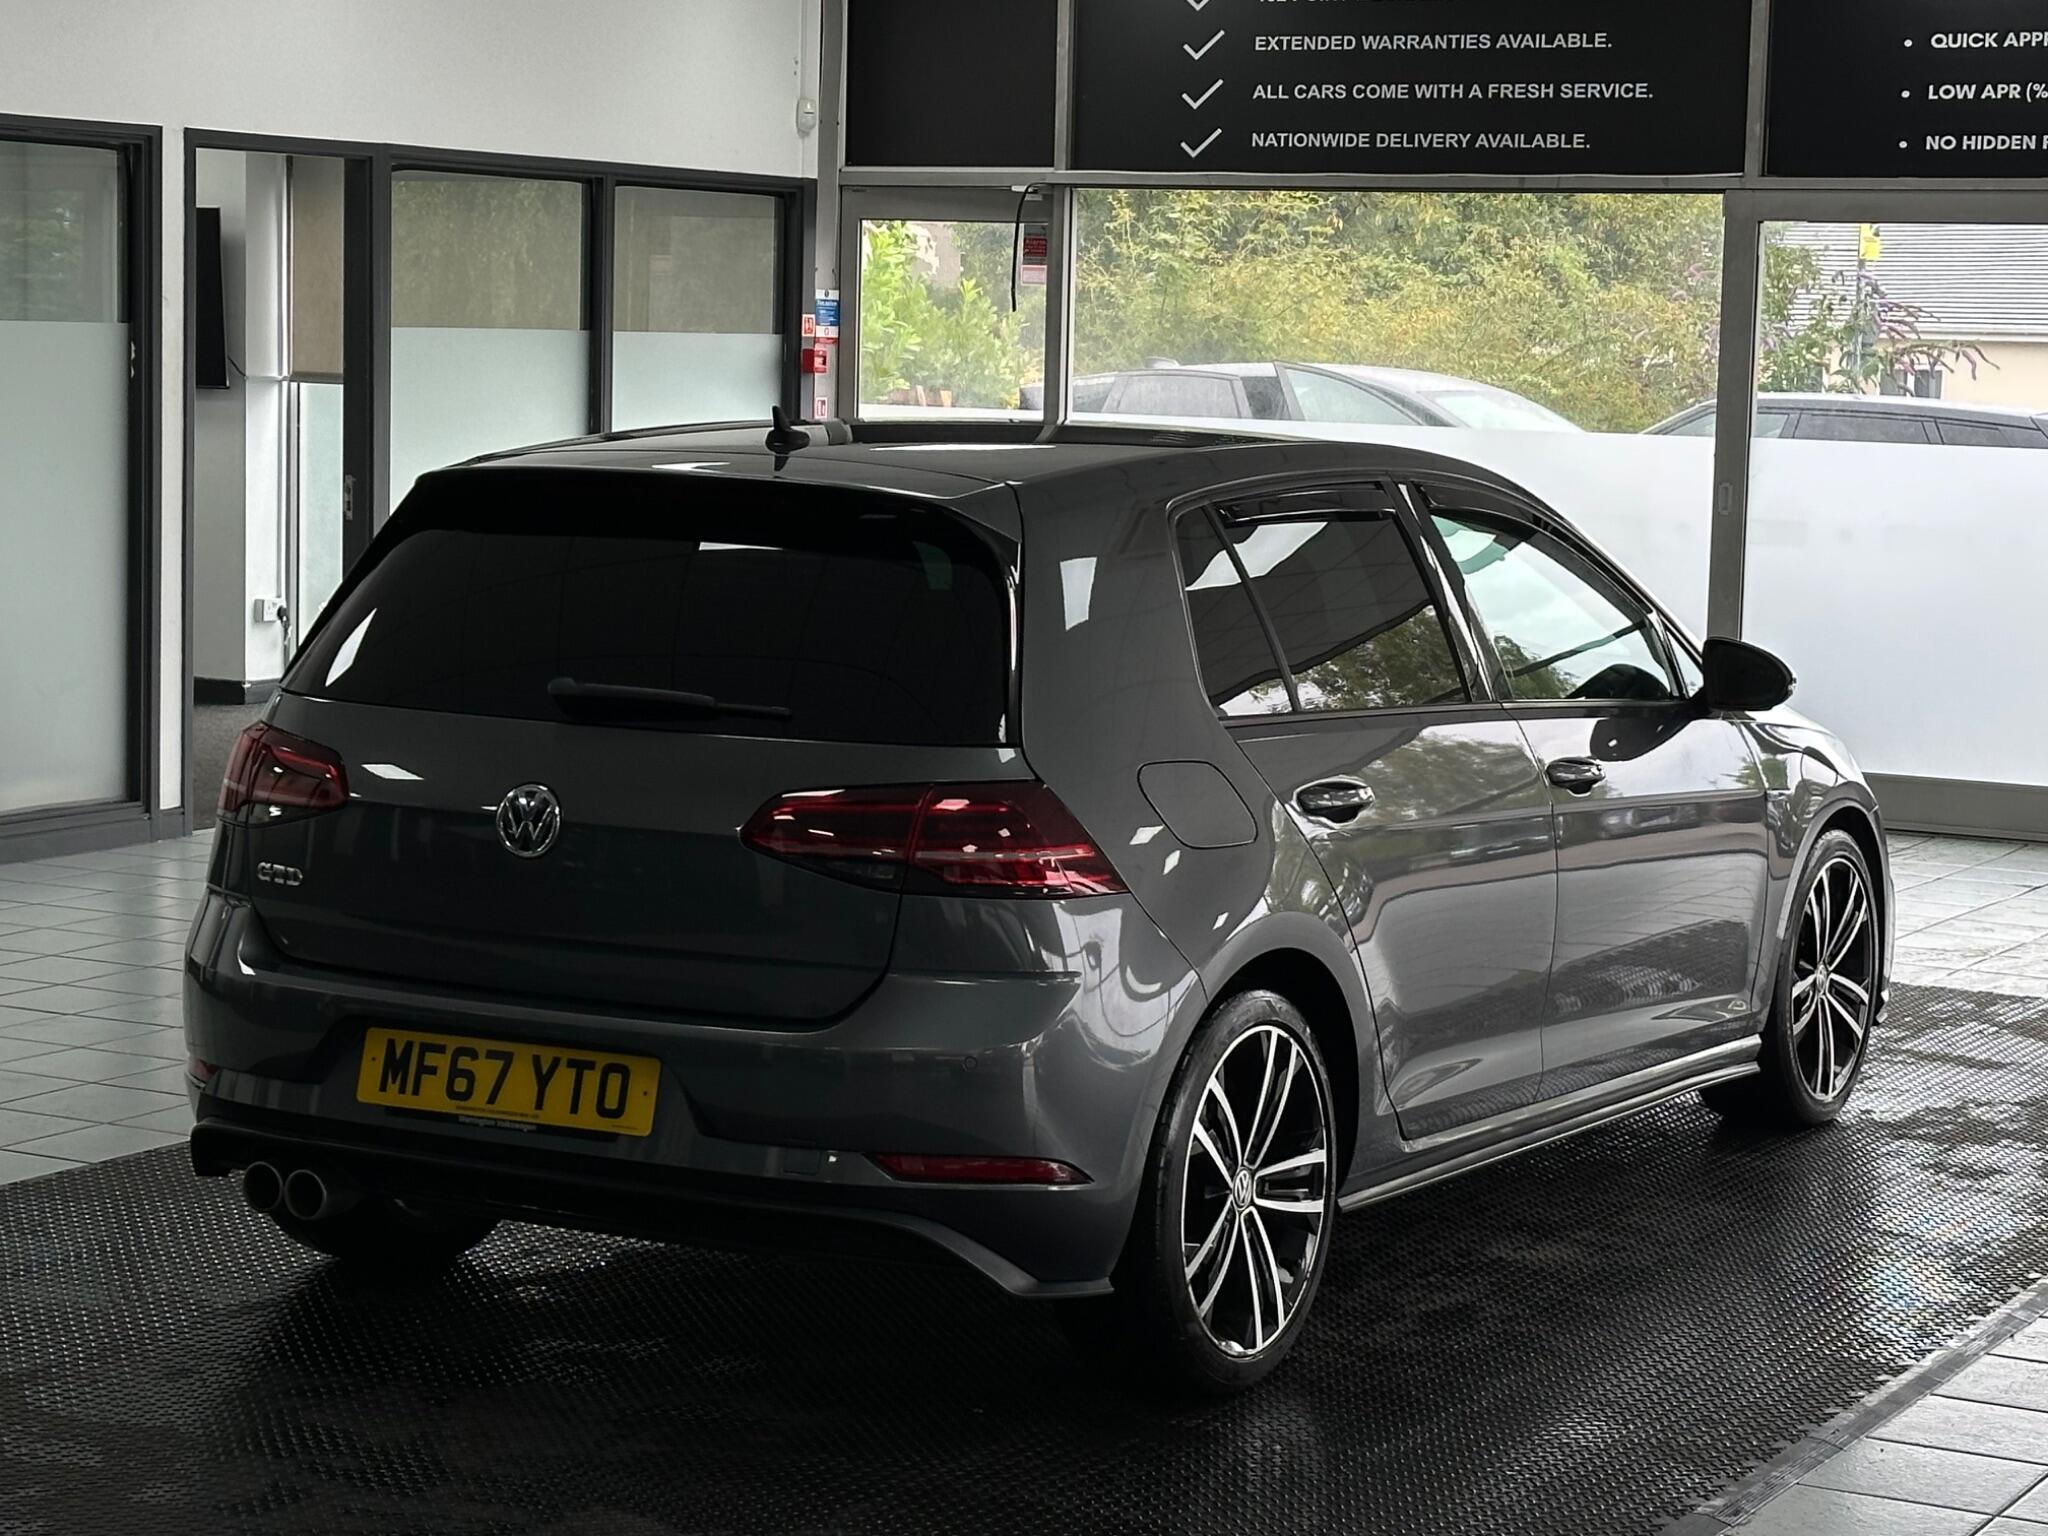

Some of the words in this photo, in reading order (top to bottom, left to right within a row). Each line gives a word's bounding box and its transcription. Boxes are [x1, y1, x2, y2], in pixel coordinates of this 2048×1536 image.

[1254, 35, 1356, 51] EXTENDED
[1361, 33, 1491, 50] WARRANTIES
[1495, 32, 1612, 49] AVAILABLE.
[1930, 31, 1999, 48] QUICK
[1252, 84, 1290, 100] ALL
[1294, 84, 1347, 99] CARS
[1352, 84, 1410, 99] COME
[1414, 83, 1464, 99] WITH
[1468, 83, 1483, 99] A
[1488, 83, 1554, 99] FRESH
[1559, 82, 1653, 99] SERVICE.
[1928, 84, 1977, 100] LOW
[1980, 83, 2022, 99] APR
[1251, 132, 1371, 148] NATIONWIDE
[1376, 132, 1472, 148] DELIVERY
[1474, 132, 1590, 149] AVAILABLE.
[1925, 135, 1957, 151] NO
[1962, 134, 2037, 150] HIDDEN
[256, 860, 304, 886] GTD
[378, 1037, 515, 1106] MF67
[531, 1053, 632, 1119] YTO
